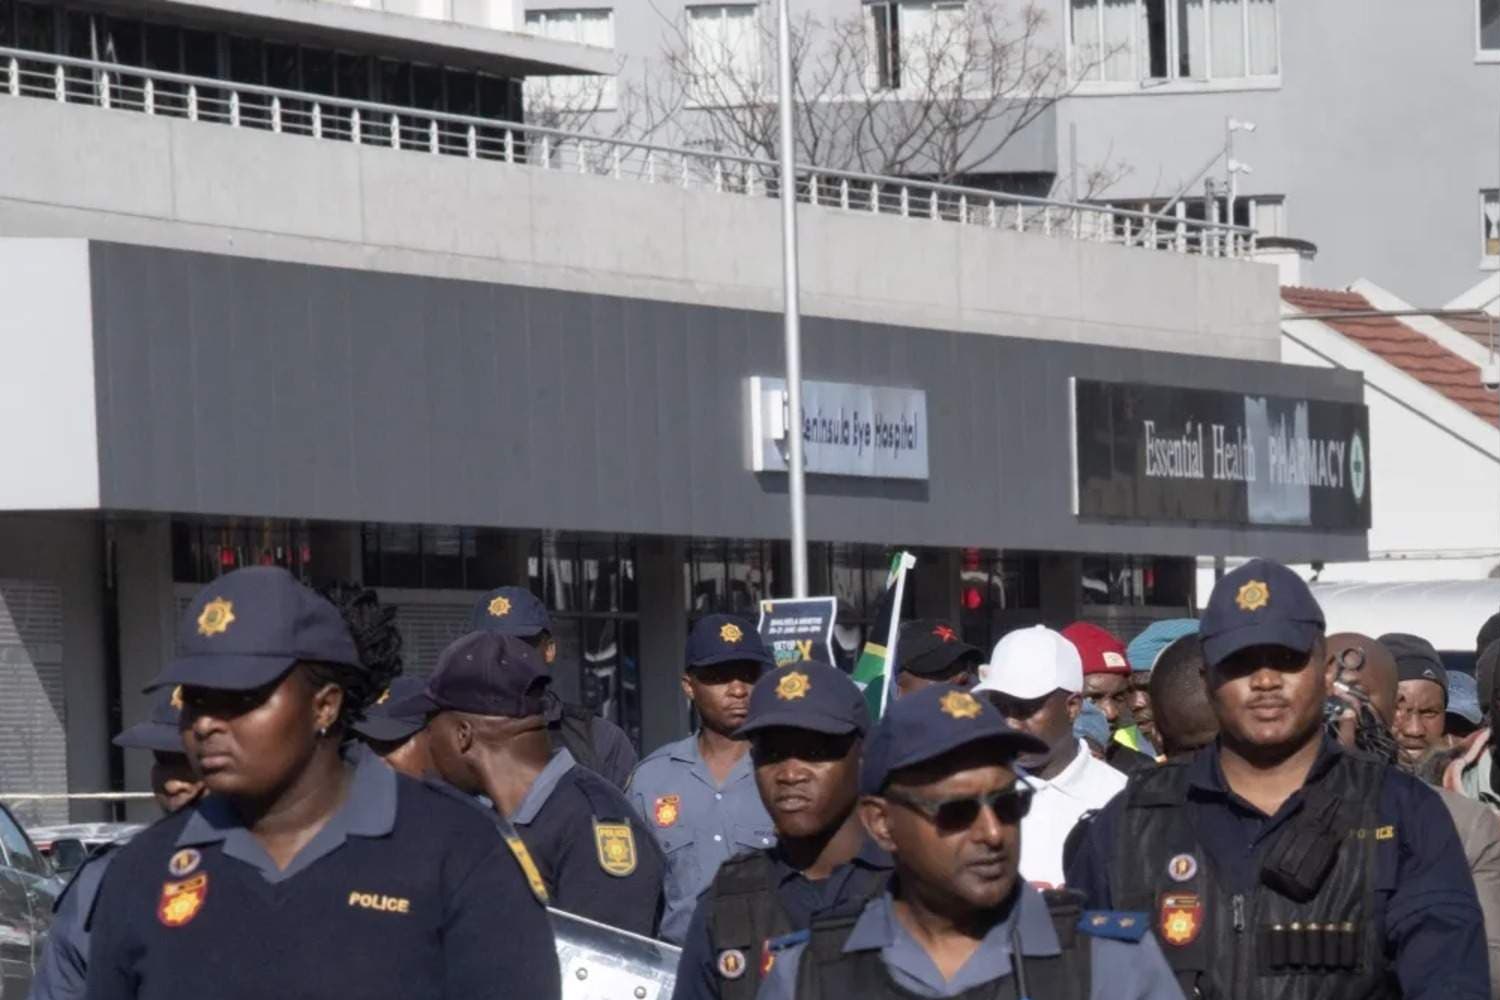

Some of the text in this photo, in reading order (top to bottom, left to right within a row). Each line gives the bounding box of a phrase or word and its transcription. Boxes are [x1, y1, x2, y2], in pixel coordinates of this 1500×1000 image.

[801, 406, 918, 459] eninsula Eye Hospital
[1144, 419, 1256, 481] Essential Health
[1268, 434, 1346, 487] PHARMACY
[348, 890, 410, 913] POLICE
